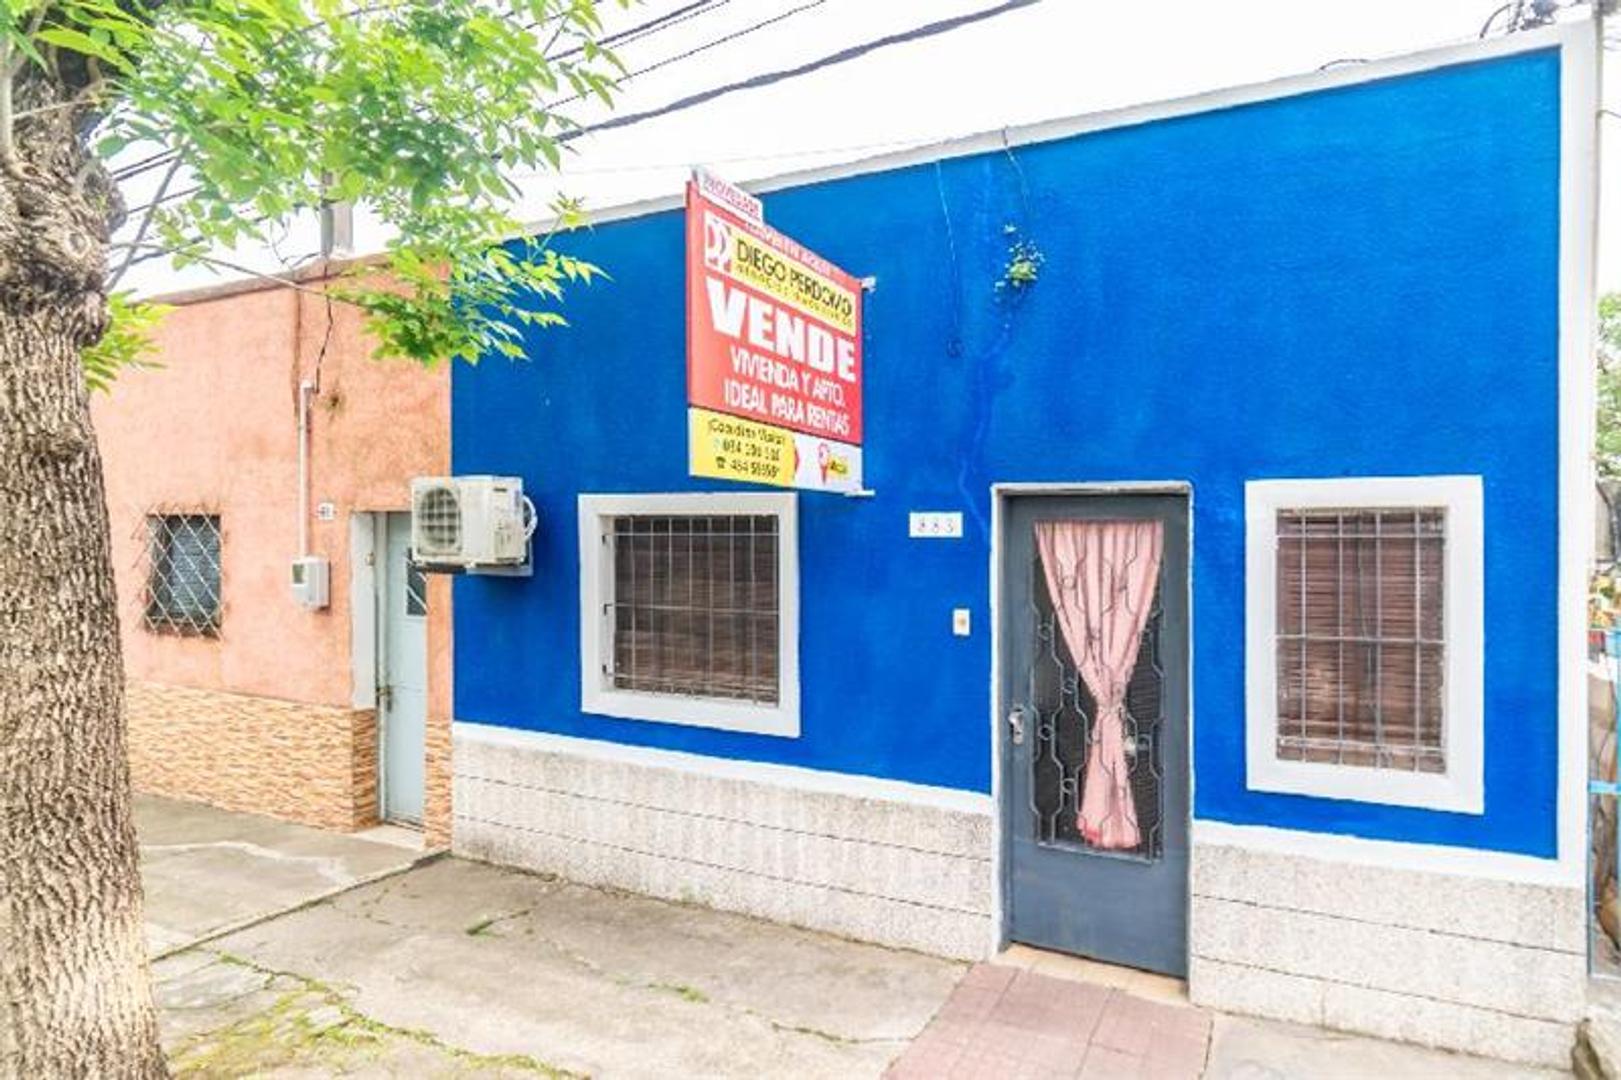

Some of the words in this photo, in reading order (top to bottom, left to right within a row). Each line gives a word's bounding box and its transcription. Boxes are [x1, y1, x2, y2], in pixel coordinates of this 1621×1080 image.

[737, 238, 786, 282] DIEGO
[706, 275, 857, 382] VENDE
[730, 345, 799, 393] VIVIENDA
[801, 370, 812, 396] Y
[724, 378, 768, 414] IDEAL
[771, 392, 805, 423] PARA
[807, 402, 850, 436] RENTAS
